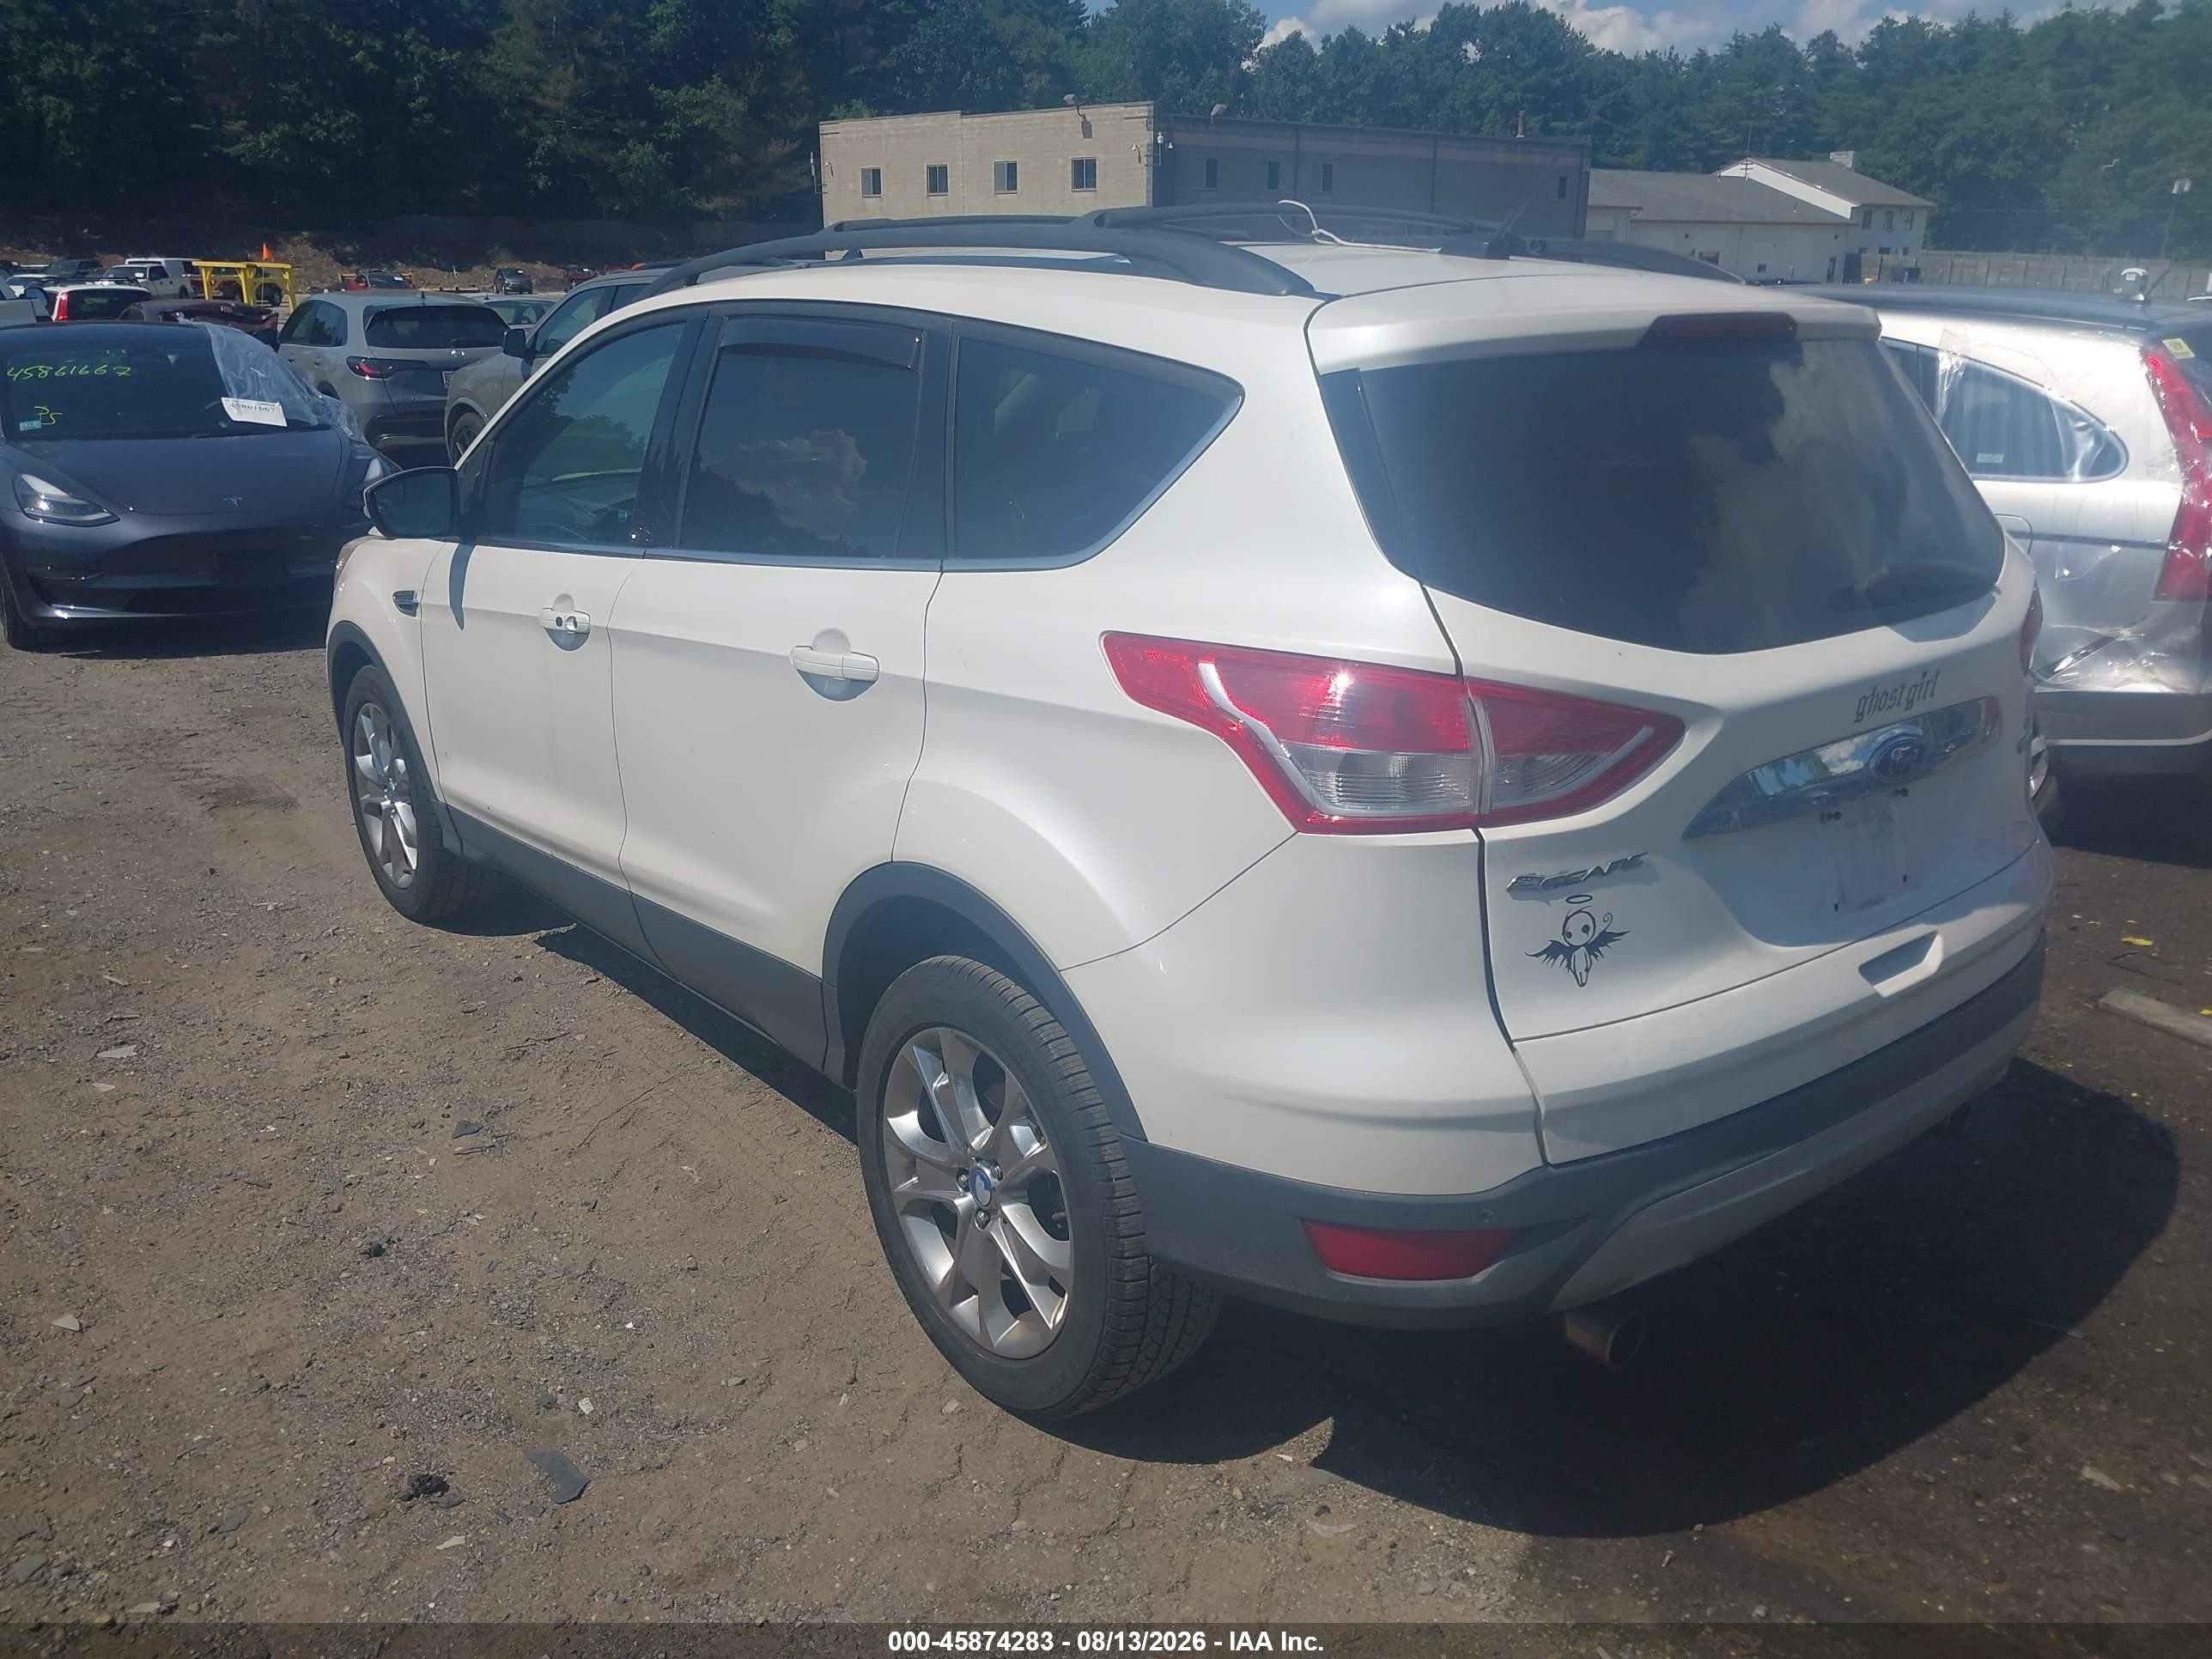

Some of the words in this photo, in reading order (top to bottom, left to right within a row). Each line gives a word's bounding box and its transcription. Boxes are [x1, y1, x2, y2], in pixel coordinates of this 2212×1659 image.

[7, 364, 131, 381] 45861667
[1853, 685, 1905, 724] ghost
[1903, 670, 1940, 712] girl
